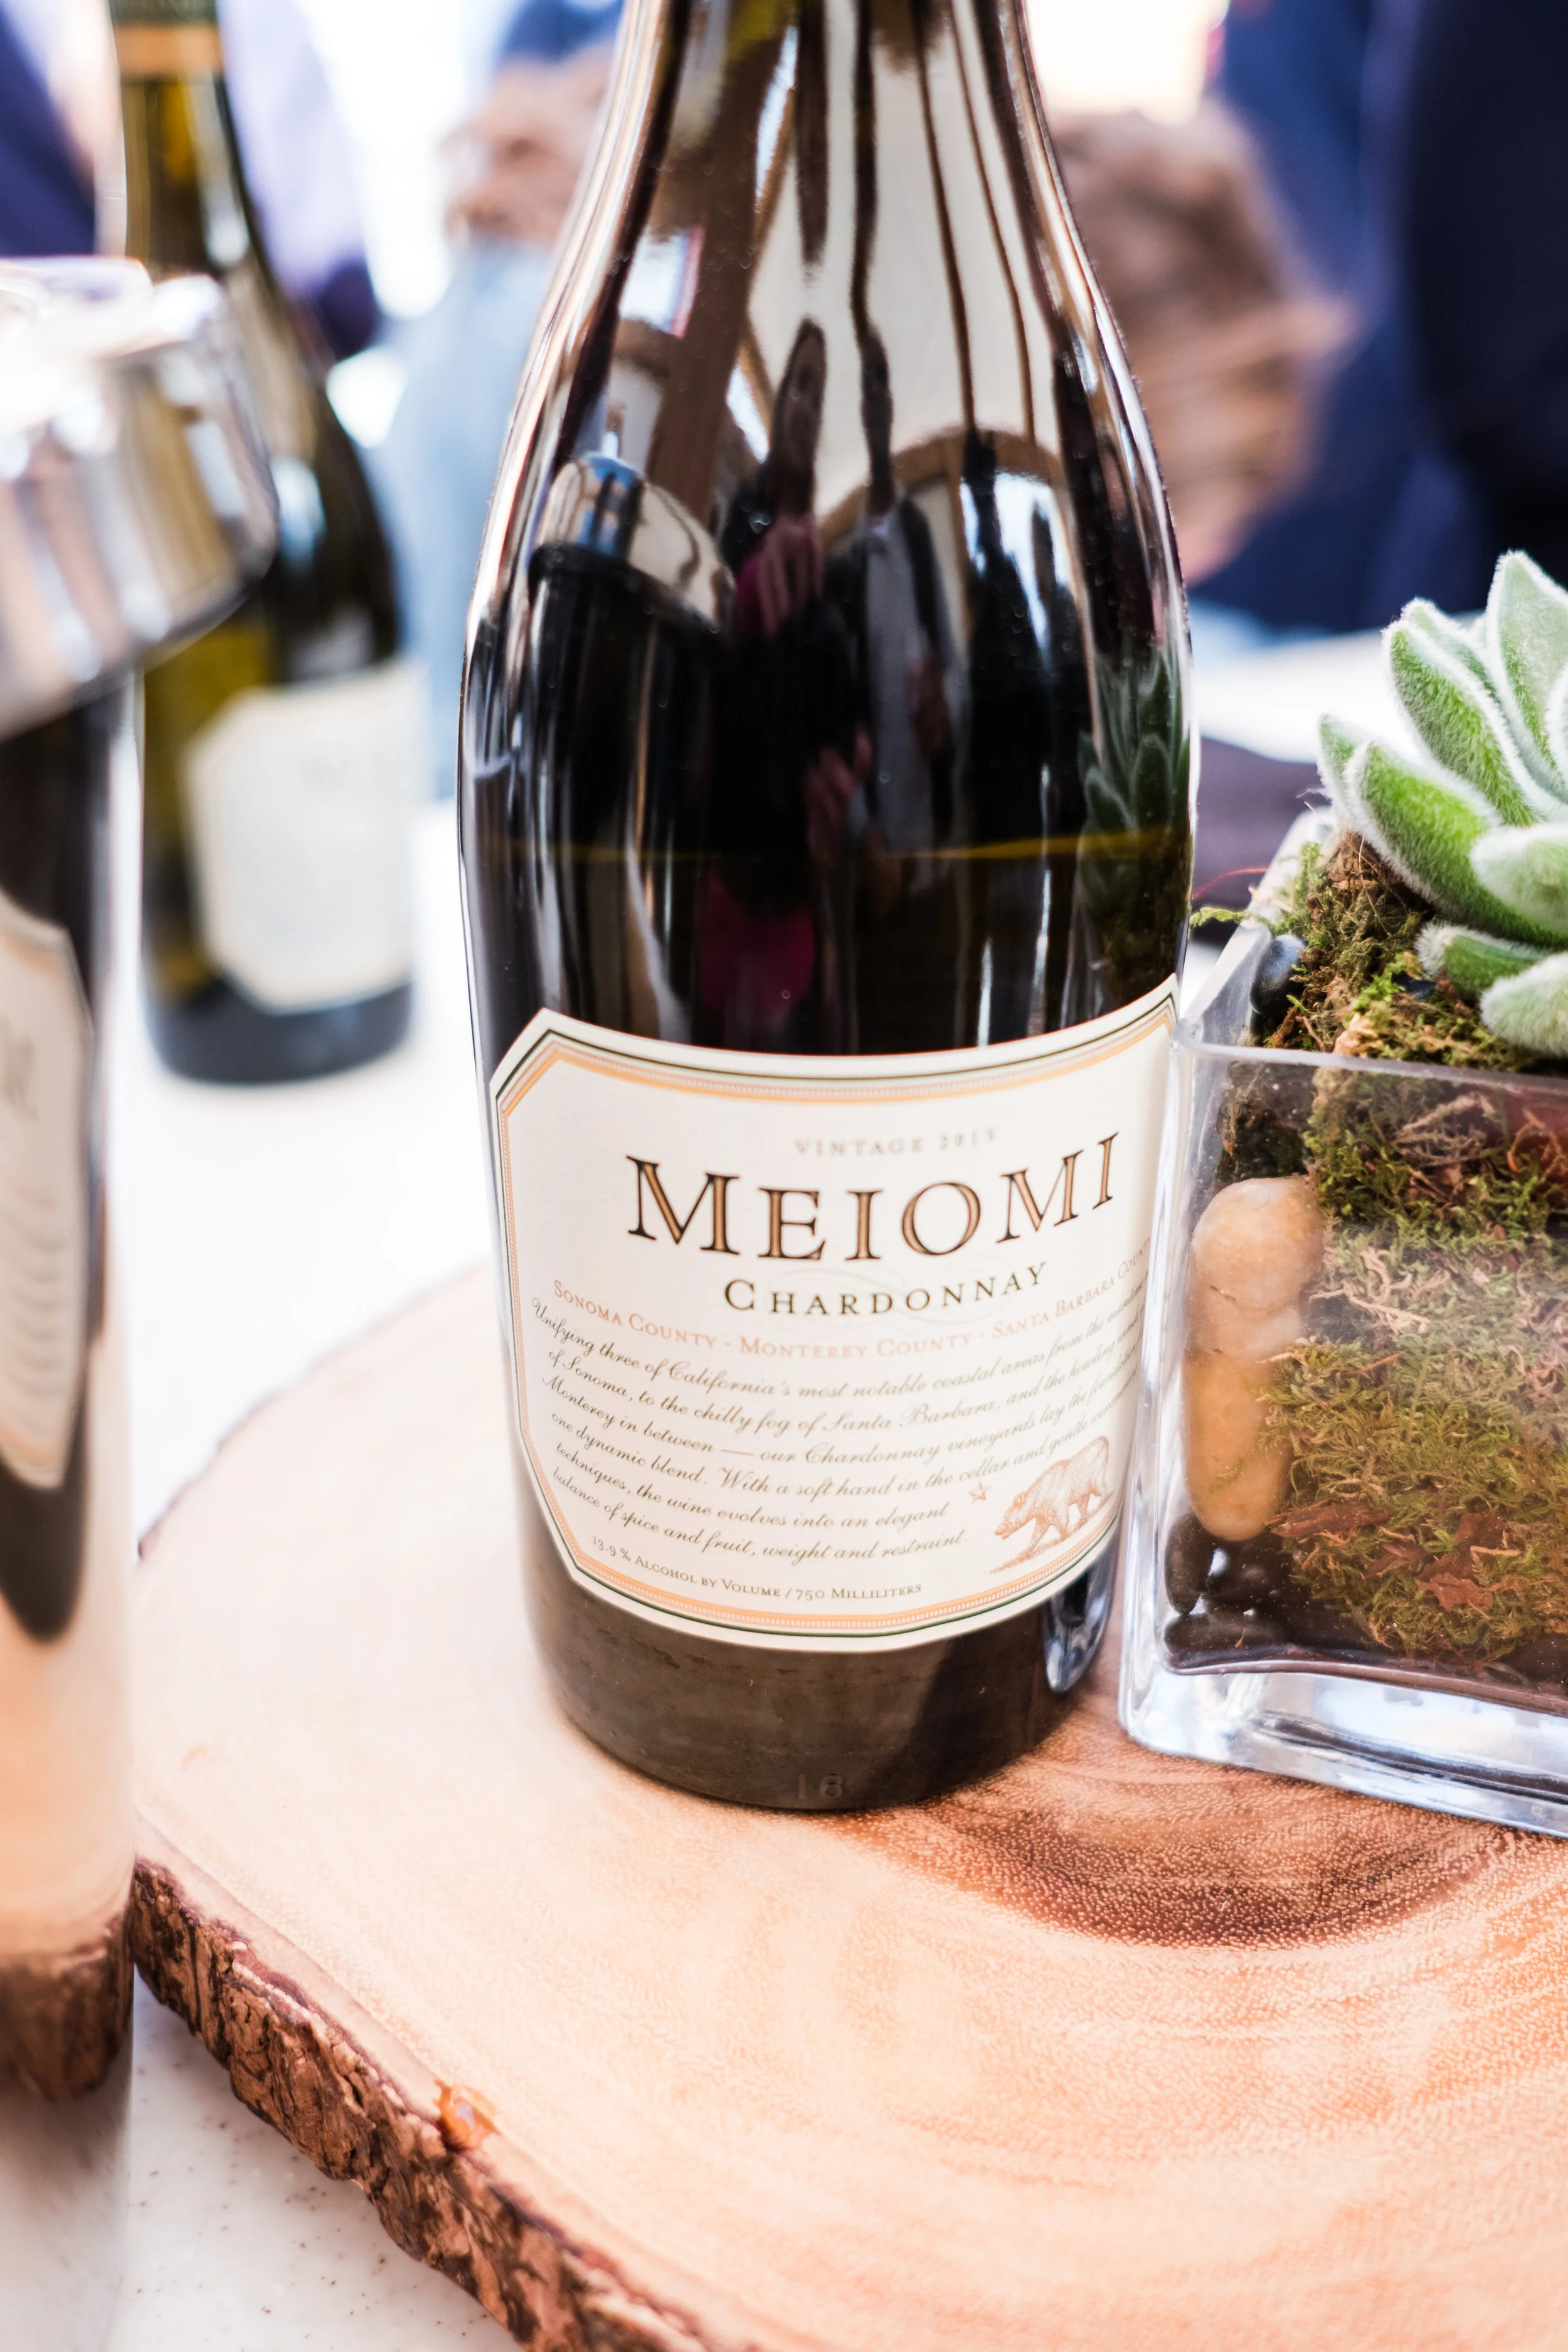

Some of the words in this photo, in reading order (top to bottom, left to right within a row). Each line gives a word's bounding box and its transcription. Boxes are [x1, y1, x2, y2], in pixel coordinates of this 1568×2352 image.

[793, 1136, 925, 1158] VINTAGE
[626, 1131, 1119, 1261] MEIOMI
[553, 1279, 622, 1326] SONOMA
[628, 1313, 718, 1348] COUNTY
[739, 1335, 867, 1359] MONTEREY
[876, 1333, 972, 1357] COUNTY
[992, 1310, 1049, 1340] SANTA
[1055, 1277, 1114, 1318] BARBARA
[724, 1261, 1046, 1315] CHARDONNAY
[532, 1297, 595, 1357] Unifying
[600, 1342, 640, 1369] three
[645, 1358, 669, 1382] of
[669, 1360, 791, 1397] California's
[798, 1382, 849, 1398] most
[852, 1372, 927, 1397] notable
[932, 1357, 1002, 1390] coastal
[1001, 1353, 1046, 1375] areas
[1044, 1333, 1083, 1368] from
[1086, 1314, 1104, 1338] the
[549, 1349, 565, 1368] of
[563, 1355, 633, 1402] Sonoma,
[638, 1390, 655, 1406] to
[660, 1395, 689, 1415] the
[693, 1402, 753, 1434] chilly
[754, 1408, 792, 1439] fog
[797, 1411, 828, 1439] of
[822, 1407, 893, 1431] Santa
[899, 1399, 1000, 1428] Barbara,
[1005, 1375, 1044, 1406] and
[1043, 1368, 1066, 1395] the
[1068, 1340, 1116, 1380] howling
[542, 1374, 616, 1429] Monterey
[619, 1415, 638, 1433] in
[643, 1421, 714, 1453] between
[760, 1451, 796, 1463] our
[805, 1443, 940, 1466] Chardonnay
[948, 1410, 1036, 1453] vineyards
[1039, 1402, 1066, 1428] lay
[1068, 1385, 1088, 1410] the
[551, 1412, 573, 1432] one
[576, 1424, 647, 1467] dynamic
[650, 1454, 708, 1485] blend.
[716, 1466, 771, 1493] With
[776, 1483, 789, 1495] a
[795, 1475, 834, 1503] soft
[835, 1474, 898, 1496] hand
[897, 1478, 919, 1493] in
[924, 1466, 954, 1488] the
[958, 1455, 1011, 1482] cellar
[1013, 1434, 1049, 1466] and
[1048, 1413, 1089, 1461] gentle
[553, 1465, 601, 1508] balance
[604, 1502, 624, 1521] of
[622, 1512, 660, 1532] spice
[664, 1528, 706, 1544] and
[701, 1530, 756, 1556] fruit,
[762, 1540, 832, 1567] weight
[834, 1540, 880, 1559] and
[881, 1528, 968, 1558] restraint.
[556, 1441, 632, 1495] techniques,
[636, 1483, 662, 1503] the
[667, 1497, 712, 1516] wine
[717, 1506, 788, 1526] evolves
[792, 1512, 835, 1528] into
[840, 1517, 870, 1528] an
[875, 1501, 951, 1533] elegant
[635, 1555, 697, 1584] ALCOHOL
[701, 1578, 718, 1588] BY
[721, 1577, 781, 1597] VOLUME
[830, 1583, 922, 1599] MILLILITERS
